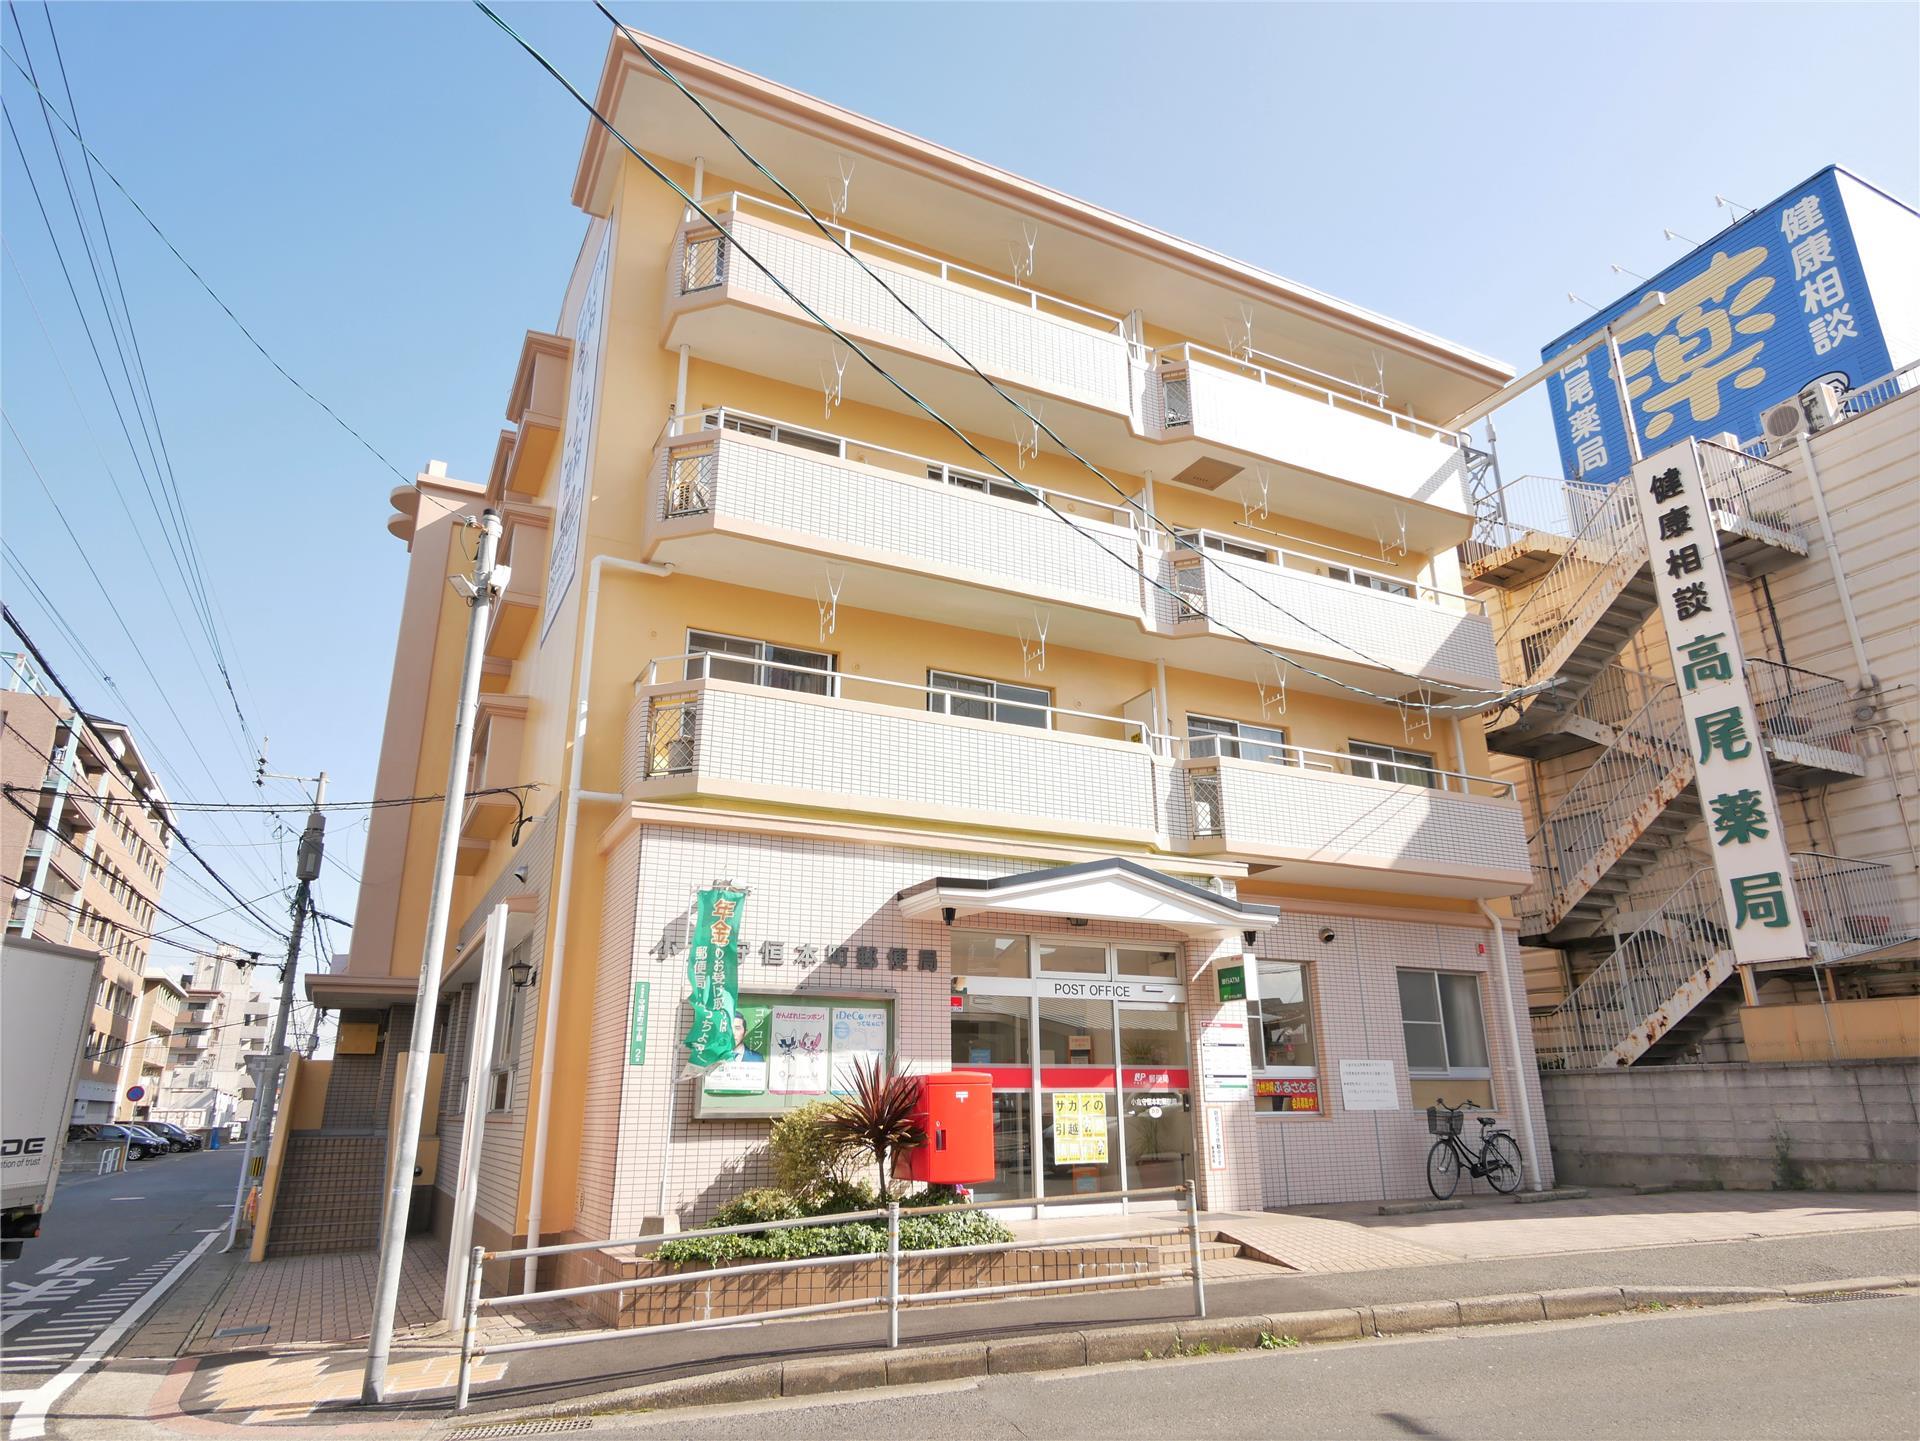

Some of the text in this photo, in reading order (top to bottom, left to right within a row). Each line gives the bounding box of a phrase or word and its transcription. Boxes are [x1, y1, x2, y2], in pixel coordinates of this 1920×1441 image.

[1780, 194, 1858, 356] 健康相談
[1608, 246, 1776, 440] 薬
[1649, 466, 1792, 930] 健康相談 高尾薬局
[649, 938, 939, 974] 小守恒本町郵便局
[1054, 982, 1131, 997] POST OFFICE
[753, 1008, 765, 1051] コツコツ
[1055, 1100, 1104, 1112] サカイの
[1056, 1123, 1079, 1136] 引越
[1, 1137, 46, 1156] DE
[17, 1158, 25, 1167] of
[25, 1157, 41, 1166] trust
